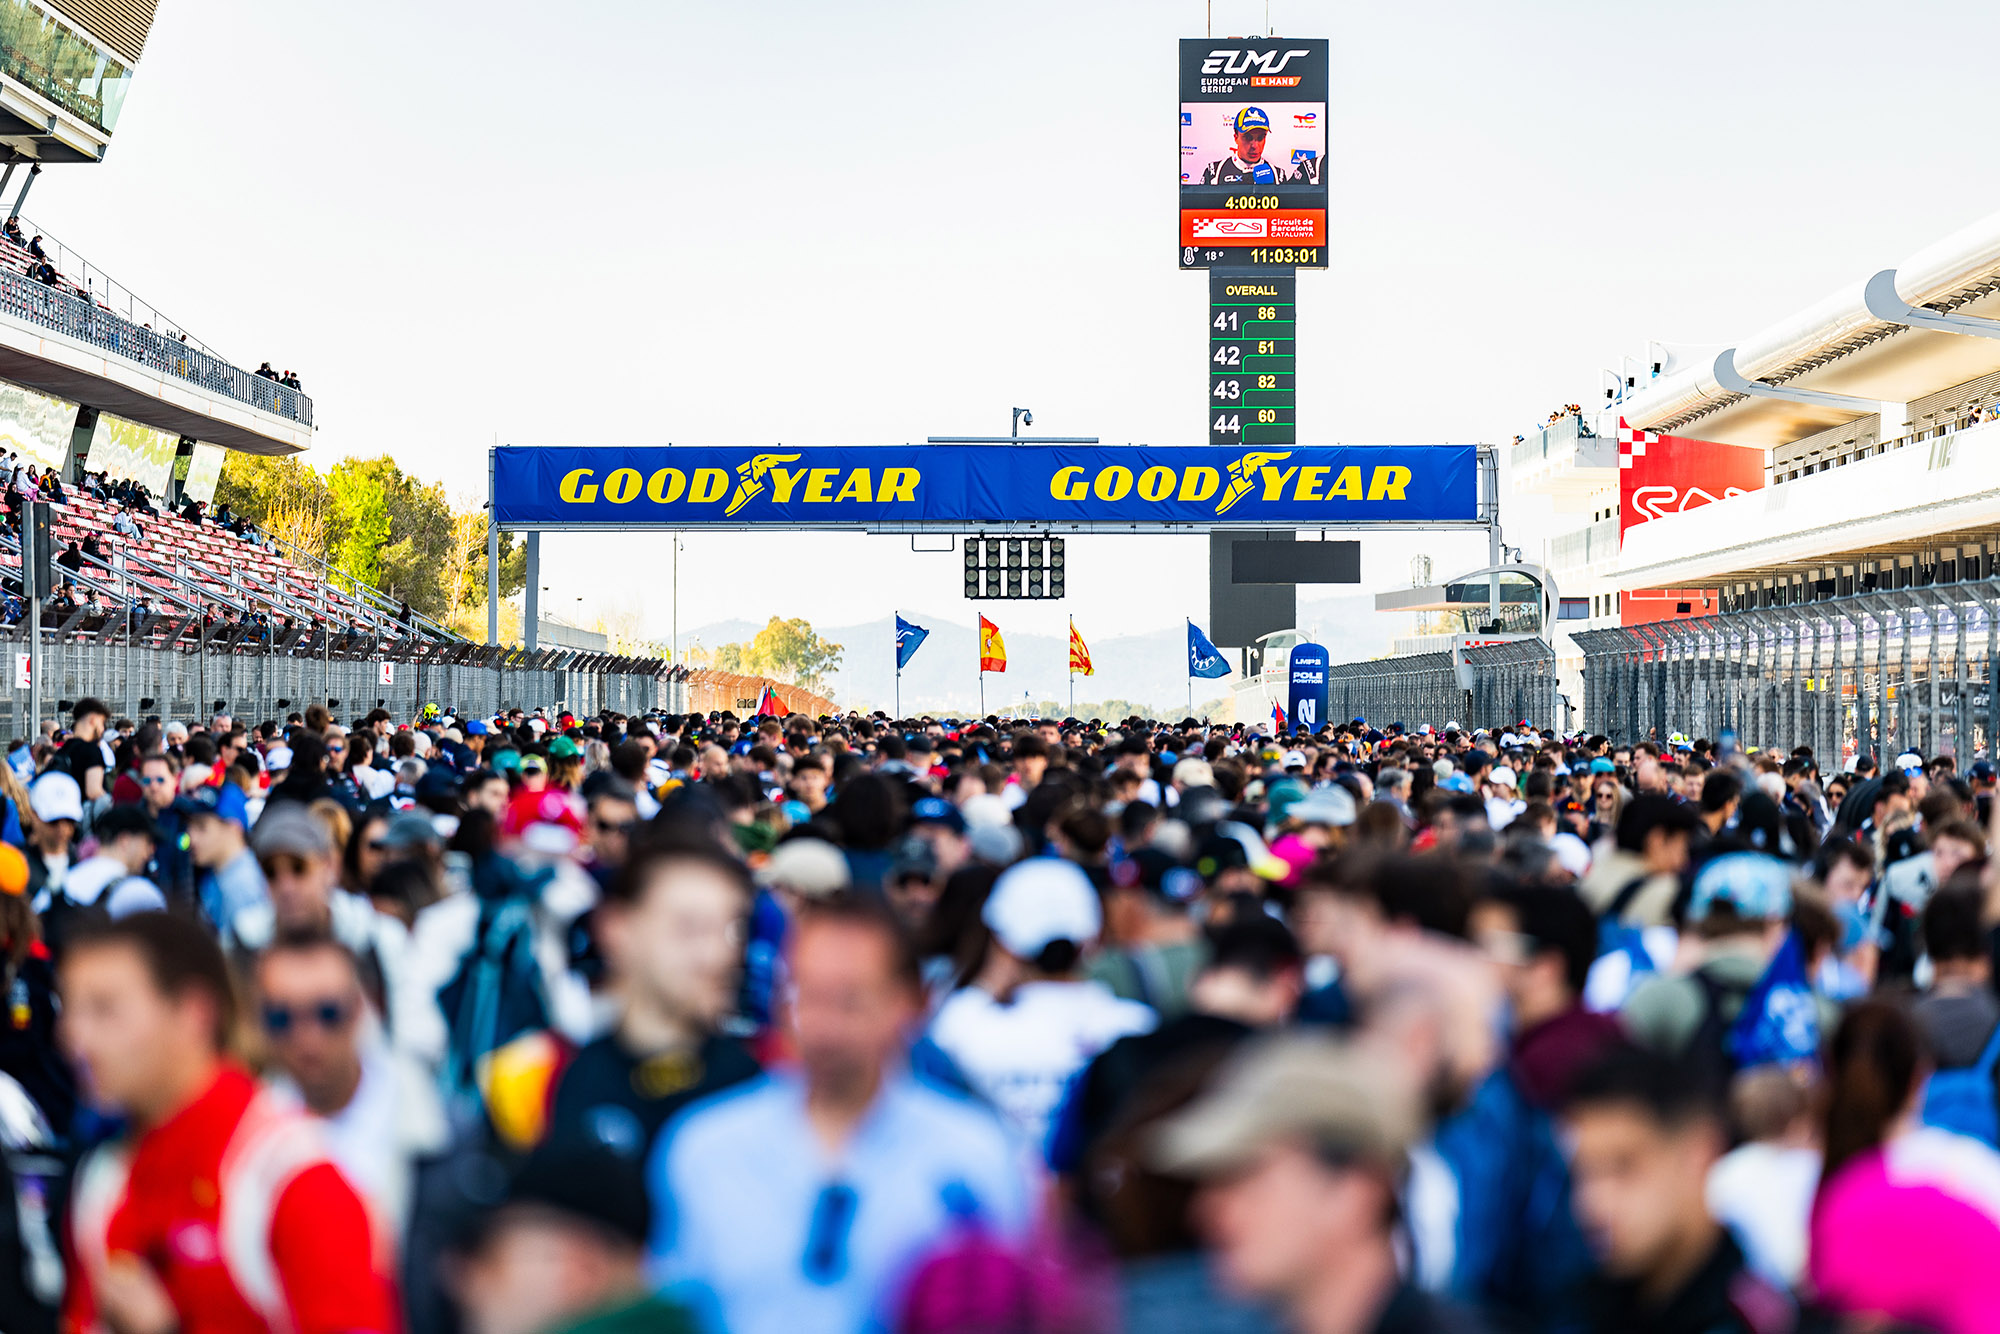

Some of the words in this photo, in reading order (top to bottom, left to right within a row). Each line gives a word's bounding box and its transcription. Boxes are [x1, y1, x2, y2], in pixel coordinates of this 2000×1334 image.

[1201, 49, 1310, 74] ELMS
[1200, 77, 1249, 86] EUROPEAN
[1200, 85, 1234, 94] SERIES
[1225, 195, 1279, 209] 4:00:00
[1271, 218, 1301, 226] Circuit
[1302, 218, 1314, 226] de
[1250, 248, 1317, 263] 11:03:01
[1225, 285, 1278, 296] OVERALL
[1257, 306, 1276, 320] 86
[1213, 311, 1238, 331] 41
[1257, 340, 1275, 354] 51
[1213, 345, 1240, 365] 42
[1257, 375, 1276, 389] 82
[1213, 380, 1240, 400] 43
[1257, 409, 1276, 423] 60
[1213, 414, 1241, 434] 44
[1293, 671, 1323, 679] POLE
